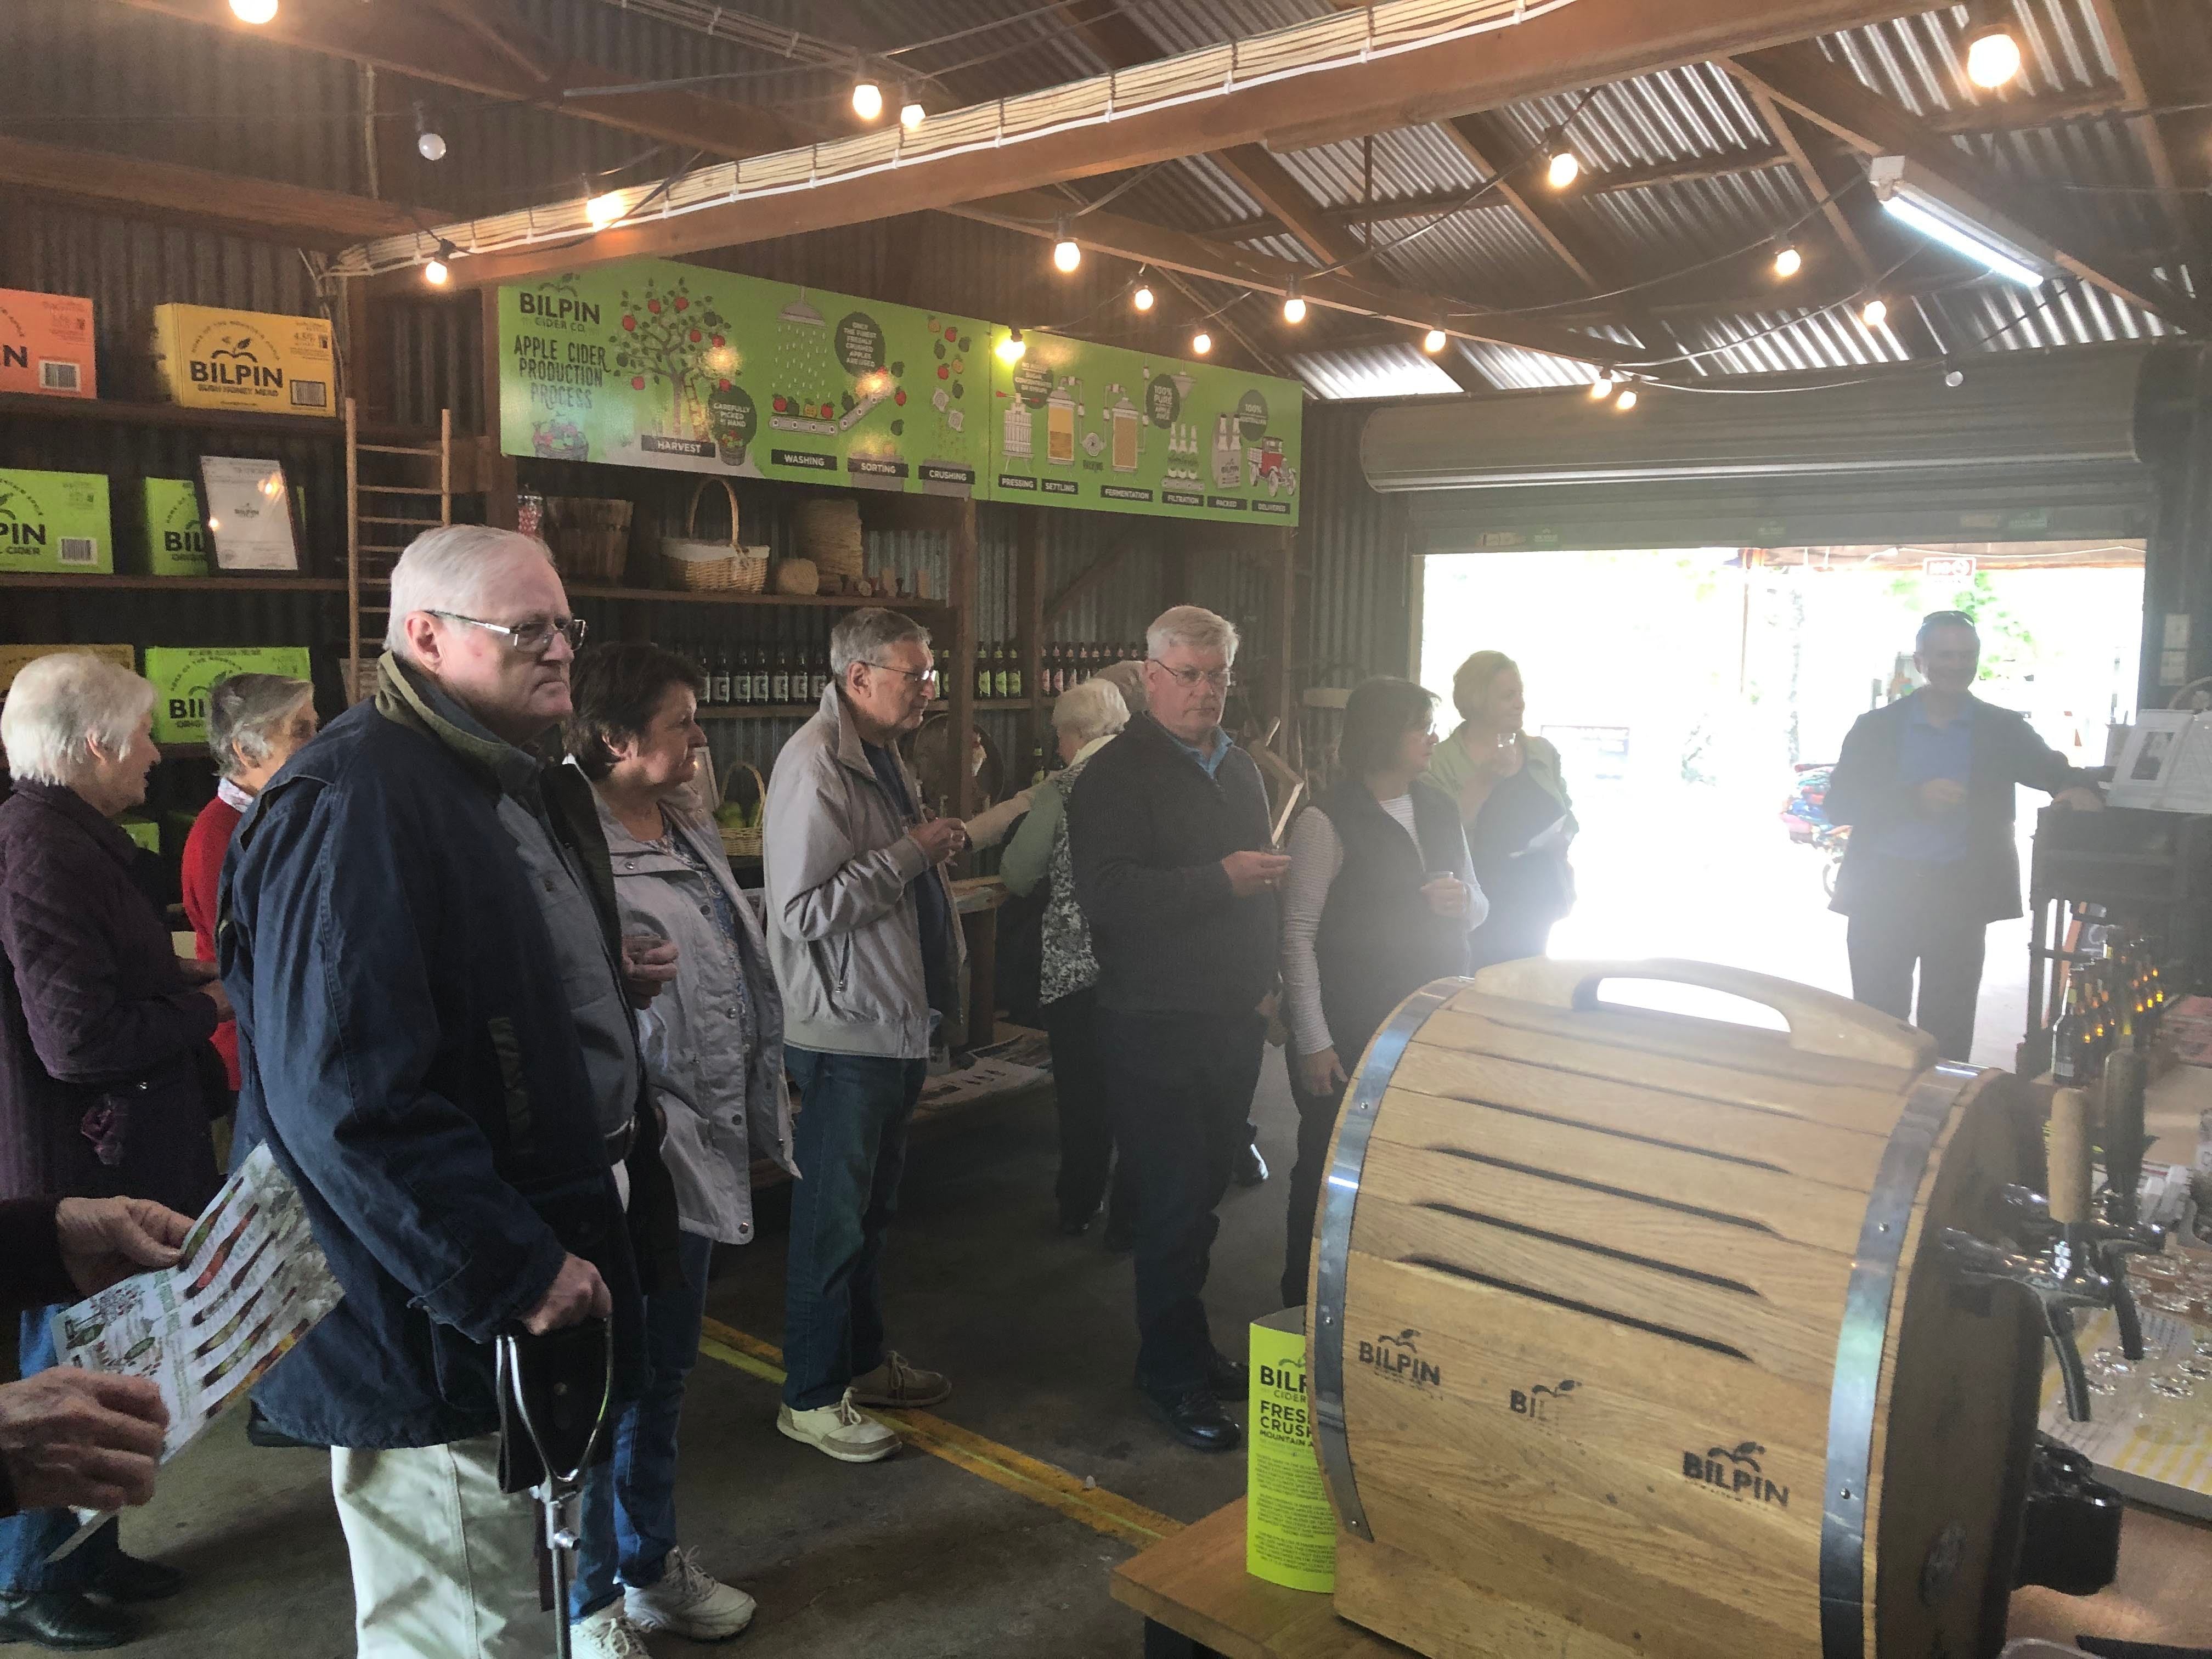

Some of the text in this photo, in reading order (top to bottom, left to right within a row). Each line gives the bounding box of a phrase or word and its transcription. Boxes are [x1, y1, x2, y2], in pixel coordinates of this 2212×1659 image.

[520, 292, 600, 325] BILPIN
[535, 317, 567, 330] CIDER
[514, 335, 612, 373] APPLE CIDER
[189, 360, 283, 388] BILPIN
[519, 358, 603, 387] PRODUCTION
[531, 382, 592, 410] PROCESS
[1154, 385, 1173, 396] 100%
[1153, 394, 1173, 405] PURE
[714, 403, 751, 413] CAREFULLY
[1245, 403, 1262, 413] 100%
[720, 411, 744, 420] PICKED
[1239, 416, 1267, 425] AUSTRALIAN
[727, 419, 746, 427] HAND
[658, 440, 702, 453] HARVEST
[784, 454, 825, 466] WASHING
[861, 462, 896, 474] SORTING
[929, 470, 967, 481] CRUSHING
[1002, 477, 1034, 488] PRESSING
[1045, 482, 1075, 492] SETTLING
[1105, 488, 1150, 499] FERMENTATION
[1167, 495, 1199, 504] FILTRATION
[1216, 499, 1237, 507] PACKED
[1257, 503, 1286, 512] DELIVERED
[0, 523, 47, 545] PIN
[165, 531, 204, 552] BIL
[1359, 1340, 1441, 1386] BILPIN
[1260, 1364, 1307, 1393] BILP
[1273, 1389, 1306, 1403] CIDER
[1260, 1400, 1310, 1425] FRES
[1260, 1429, 1306, 1446] MOUNTAIN
[1682, 1451, 1790, 1507] BILPIN
